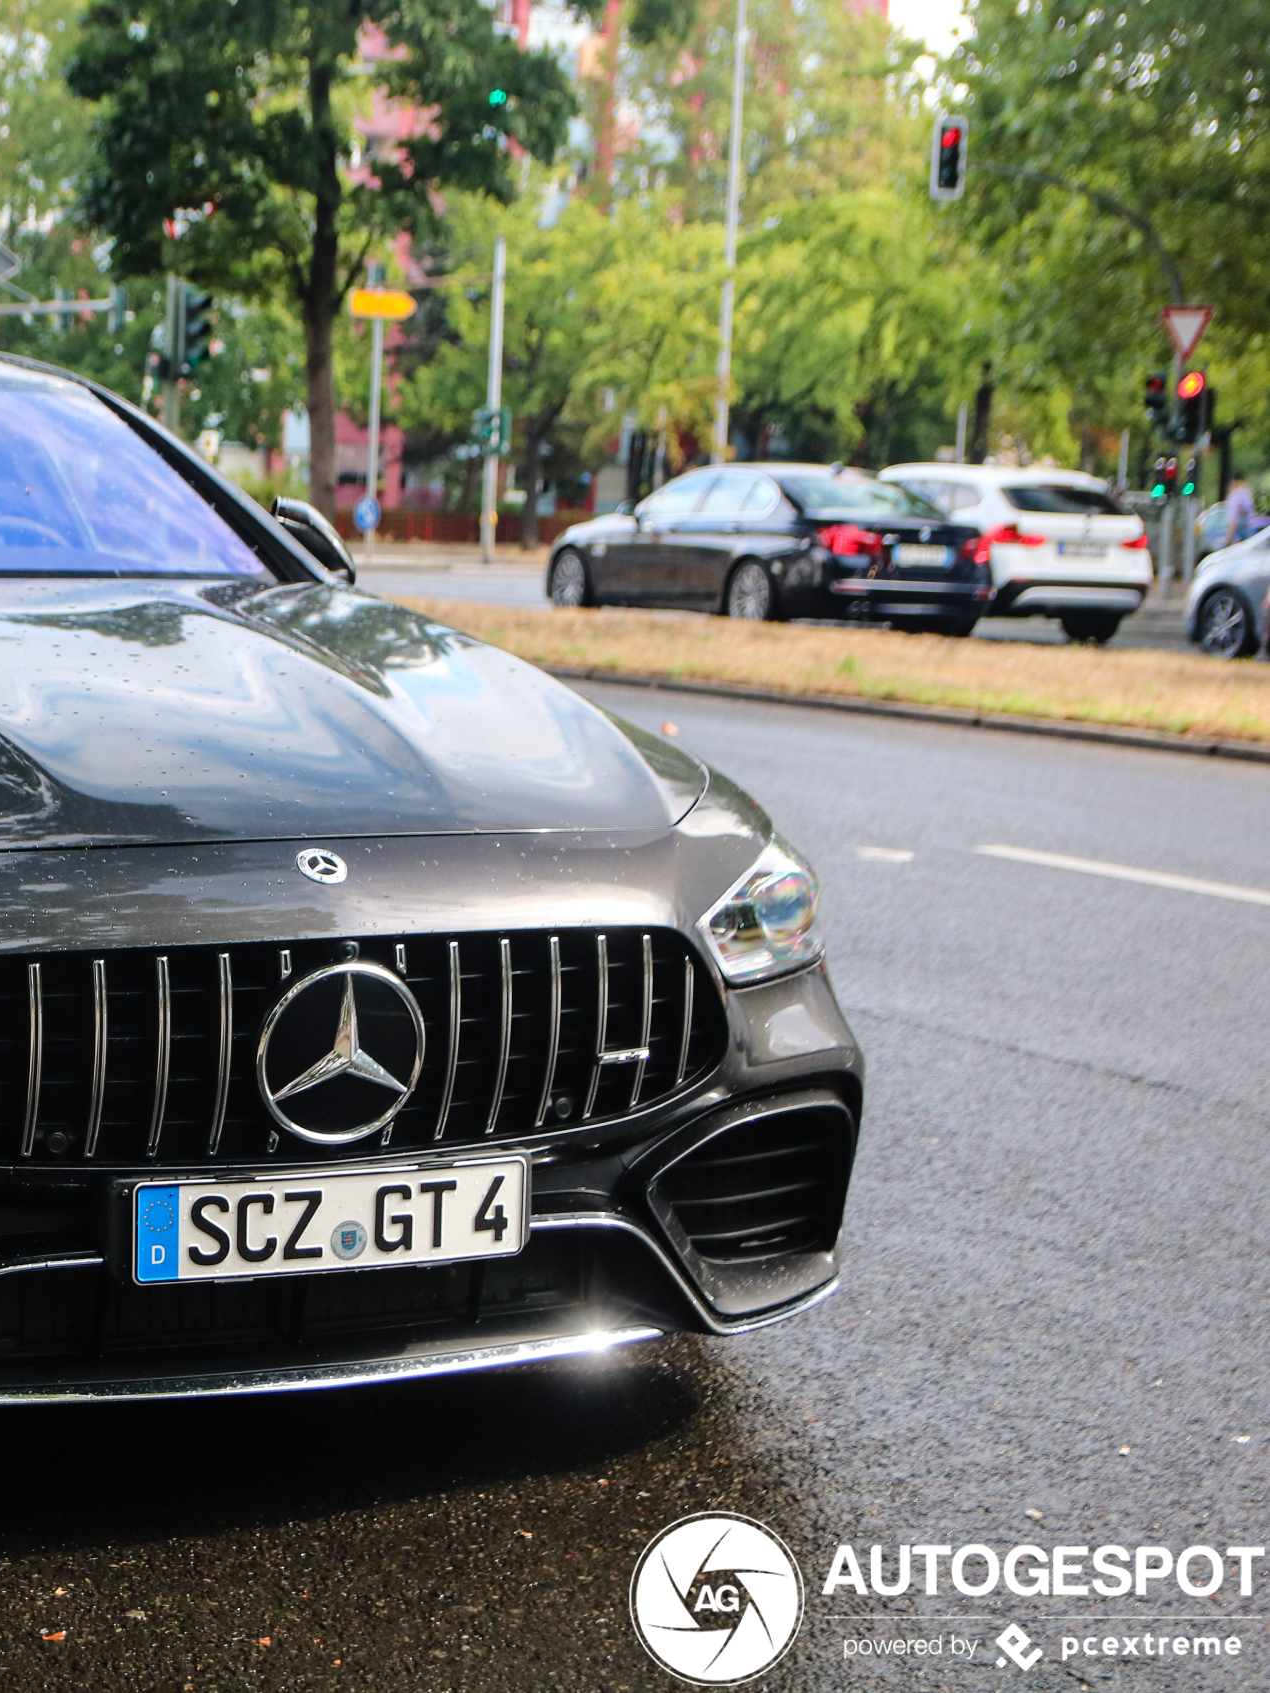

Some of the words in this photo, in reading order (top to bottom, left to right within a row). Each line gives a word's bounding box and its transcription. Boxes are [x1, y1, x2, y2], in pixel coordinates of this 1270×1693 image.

[187, 1190, 325, 1267] SCZ
[373, 1179, 458, 1253] GT
[473, 1175, 509, 1243] 4
[150, 1244, 166, 1266] D
